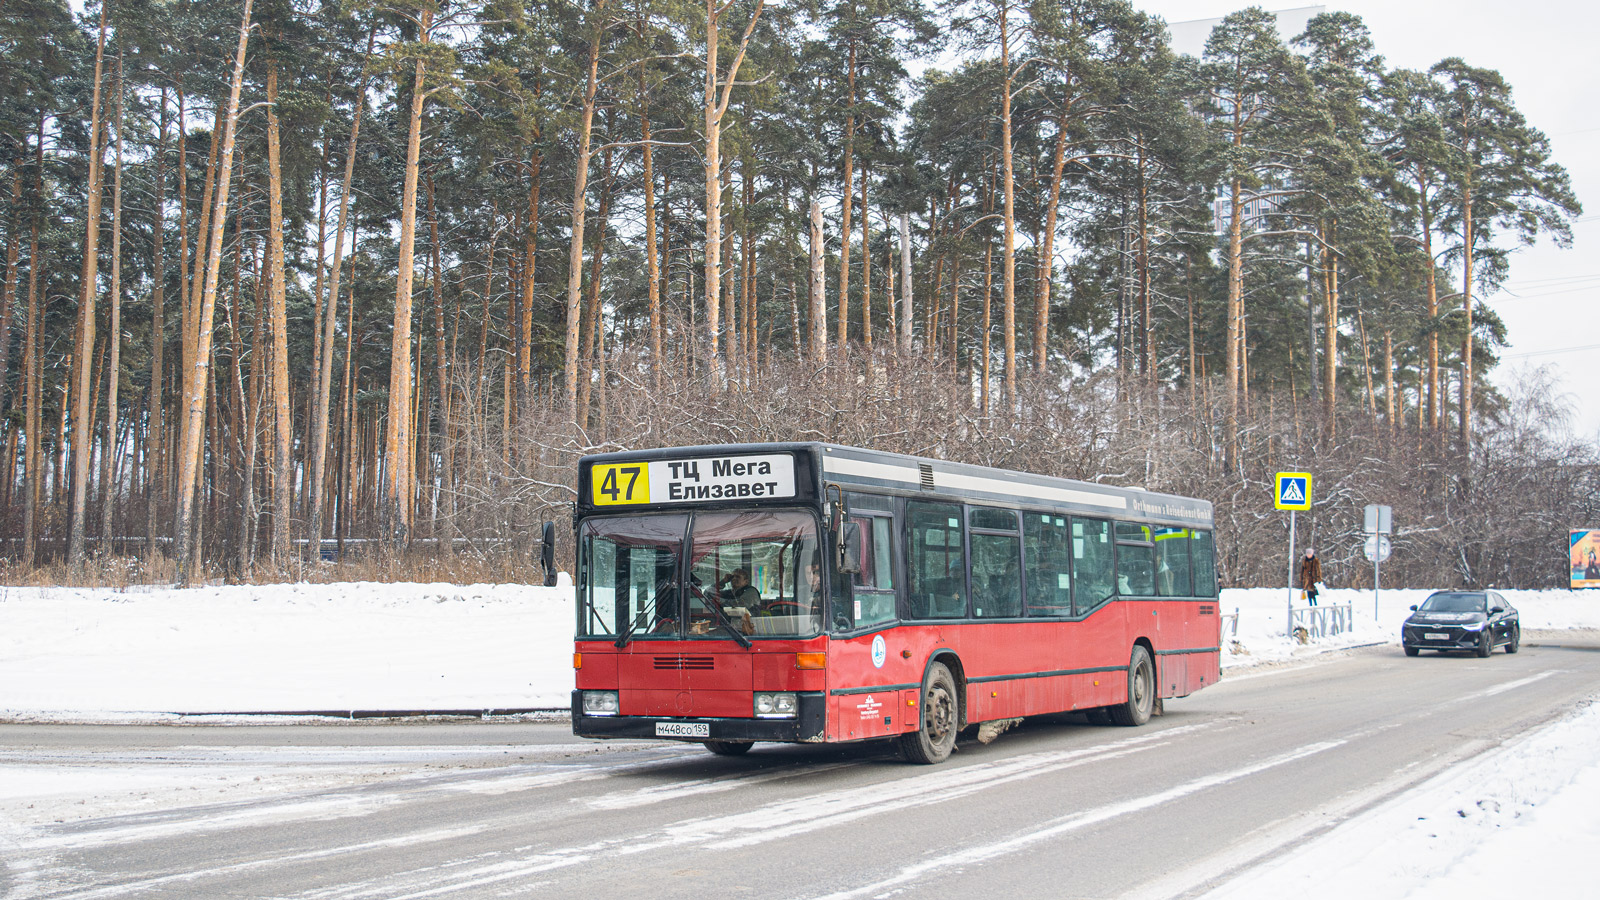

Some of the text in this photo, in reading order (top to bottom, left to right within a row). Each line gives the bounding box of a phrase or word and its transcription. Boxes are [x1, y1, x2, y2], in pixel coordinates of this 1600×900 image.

[668, 459, 771, 482] ТЦ Мега
[600, 467, 641, 501] 47
[668, 481, 778, 500] Елизавет
[694, 724, 707, 732] 159
